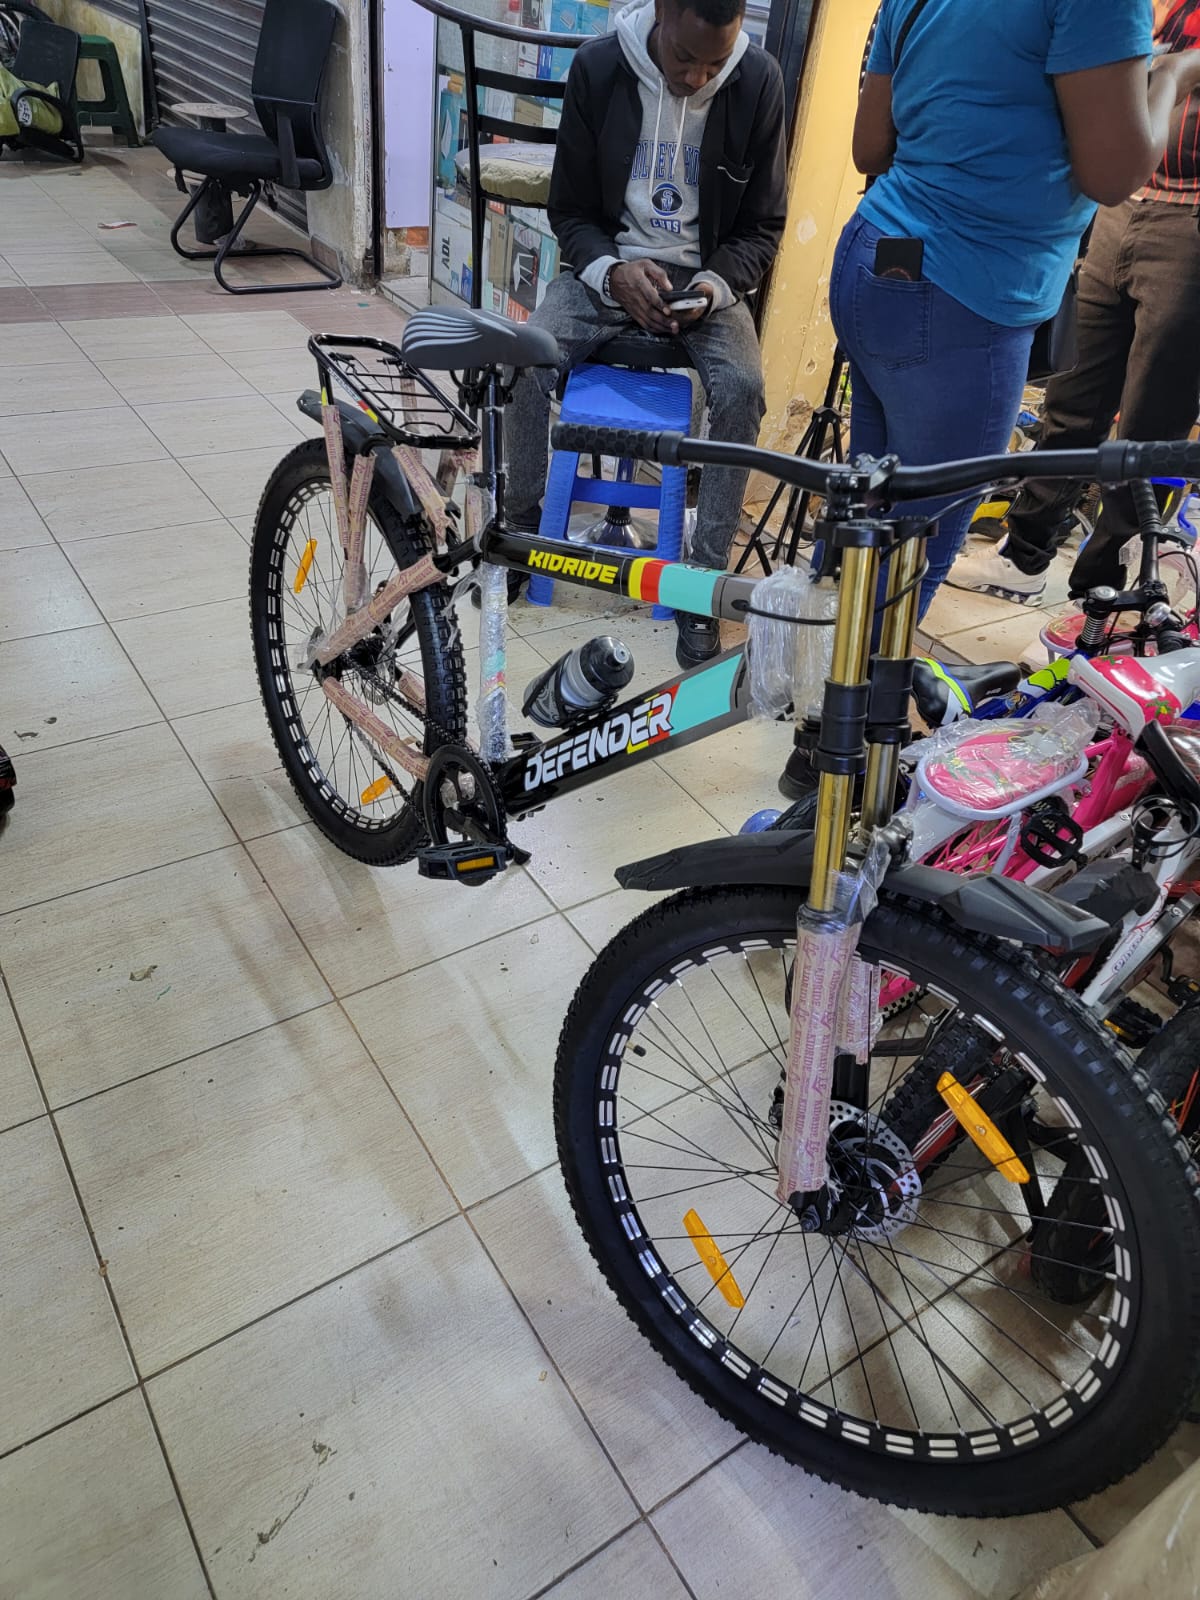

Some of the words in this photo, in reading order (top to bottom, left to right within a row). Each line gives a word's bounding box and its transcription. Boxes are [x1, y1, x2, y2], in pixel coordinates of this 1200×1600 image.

[528, 549, 619, 585] KIDRIDE
[524, 692, 674, 792] DEFENDER
[803, 1034, 816, 1072] KIDRIDE
